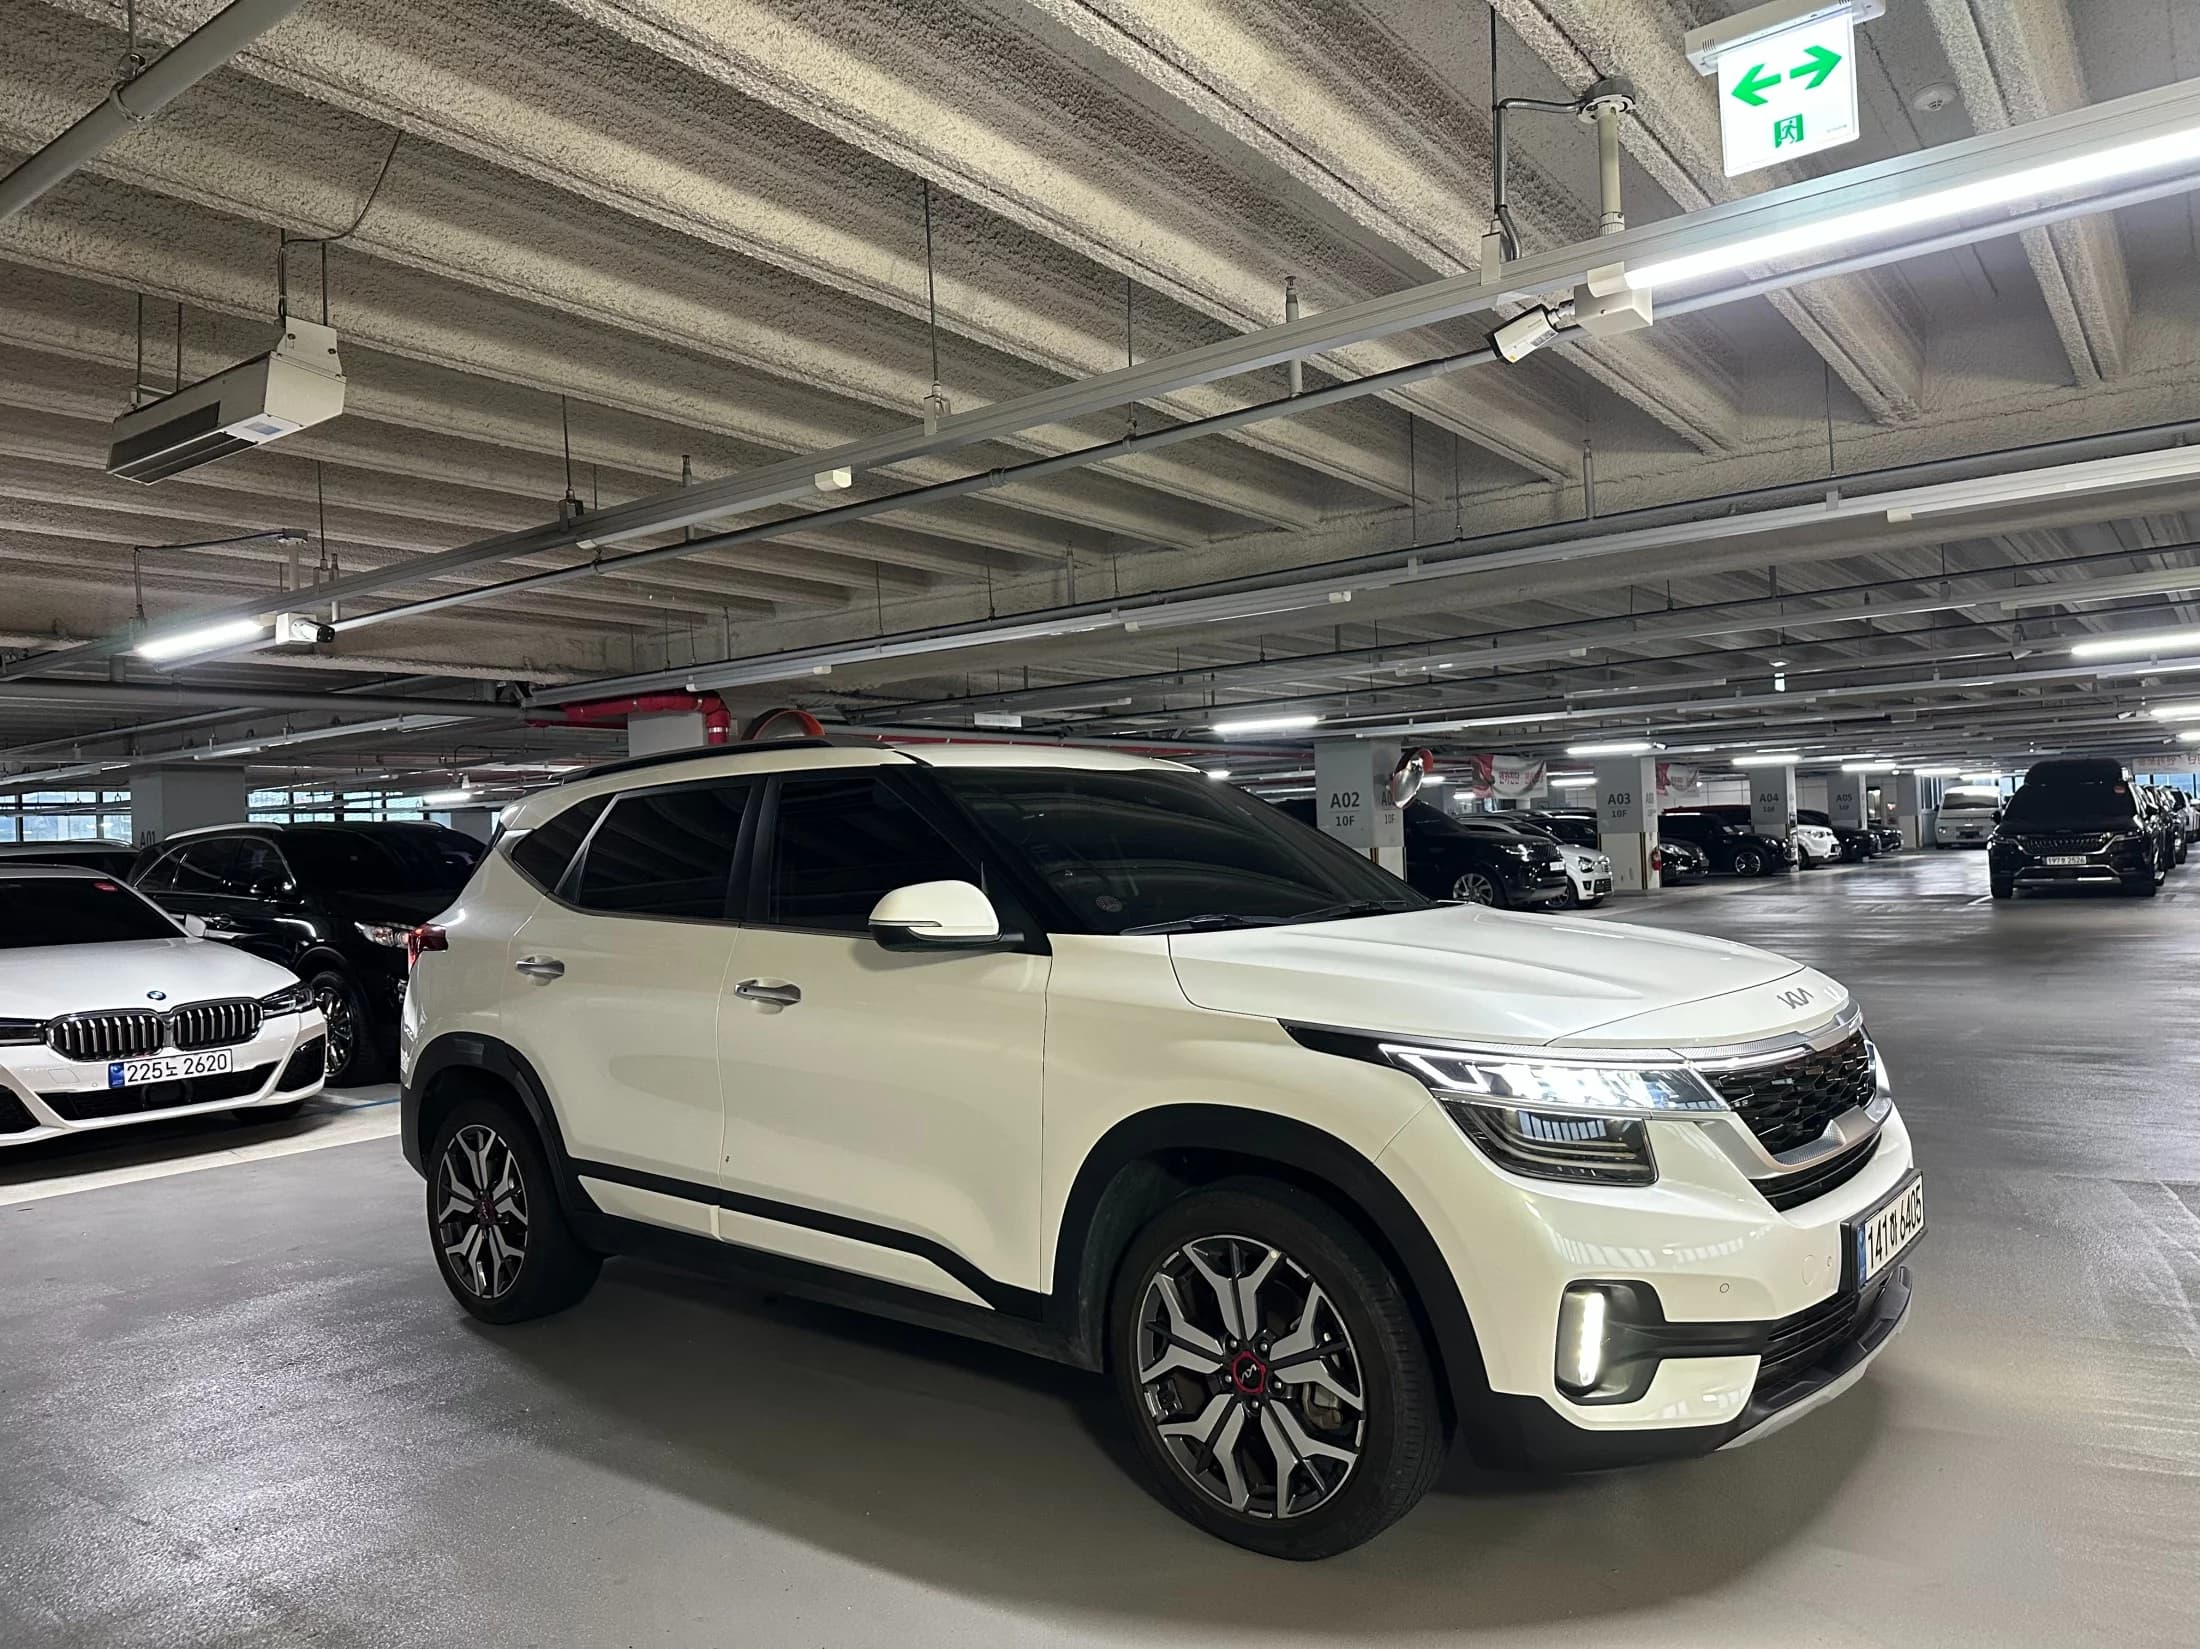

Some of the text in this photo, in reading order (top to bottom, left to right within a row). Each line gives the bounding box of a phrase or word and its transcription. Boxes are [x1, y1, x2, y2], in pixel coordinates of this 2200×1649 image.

[1330, 791, 1360, 808] A02
[1607, 793, 1631, 805] A03
[1760, 793, 1779, 802] A04
[1611, 809, 1628, 818] 10F
[1335, 815, 1355, 827] 10F
[127, 1053, 228, 1083] 225노 2620
[1900, 1184, 1922, 1241] 6405
